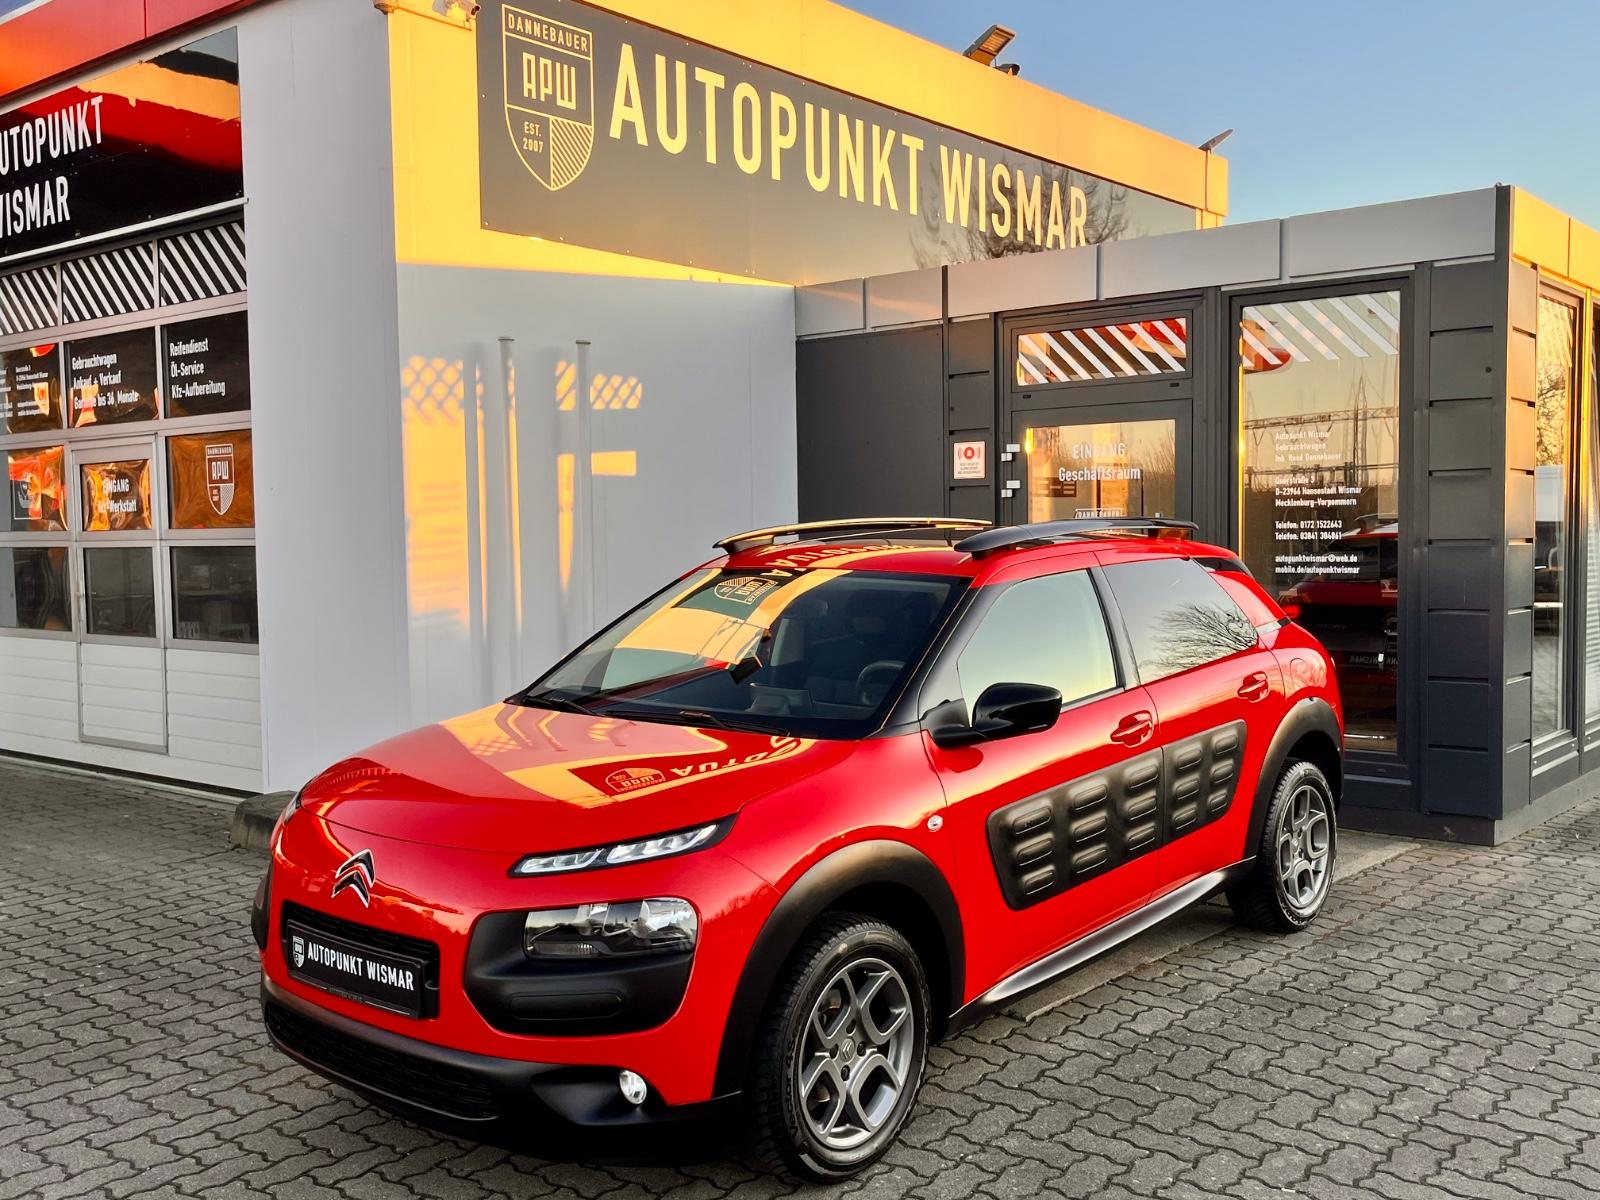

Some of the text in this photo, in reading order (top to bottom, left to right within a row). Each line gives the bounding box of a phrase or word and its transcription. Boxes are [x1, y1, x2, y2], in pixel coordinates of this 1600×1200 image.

[508, 12, 588, 53] DANNEBAUER
[522, 51, 577, 110] APW
[524, 121, 541, 136] EST.
[523, 137, 544, 153] 2007
[609, 43, 1087, 250] AUTOPUNKT WISMAR
[170, 337, 209, 357] Reifendienst
[72, 353, 117, 370] Gebrauchtwagen
[170, 360, 205, 378] Öl-Service
[100, 370, 122, 387] Verkauf
[97, 392, 106, 407] bis
[107, 391, 115, 406] 36
[117, 388, 140, 404] Monate
[171, 380, 226, 399] Kfz-Aufbereitung
[1072, 443, 1126, 460] EINNG
[1058, 466, 1141, 481] Geschäftsraum
[103, 477, 130, 493] NGANG
[1302, 486, 1337, 495] Hansestadt
[1338, 486, 1362, 494] Wismar
[98, 499, 137, 513] -Werkstatt
[1275, 497, 1357, 508] Mecklenburg-Vorpommern
[1275, 521, 1299, 529] Telefon:
[1300, 520, 1315, 529] 0172
[1275, 532, 1299, 540] Telefon:
[1275, 553, 1358, 564] autopunktwismar@web.de
[1275, 565, 1360, 576] mobile.de/autopunktwismar
[307, 941, 414, 991] AUTOPUNKT WISMAR
